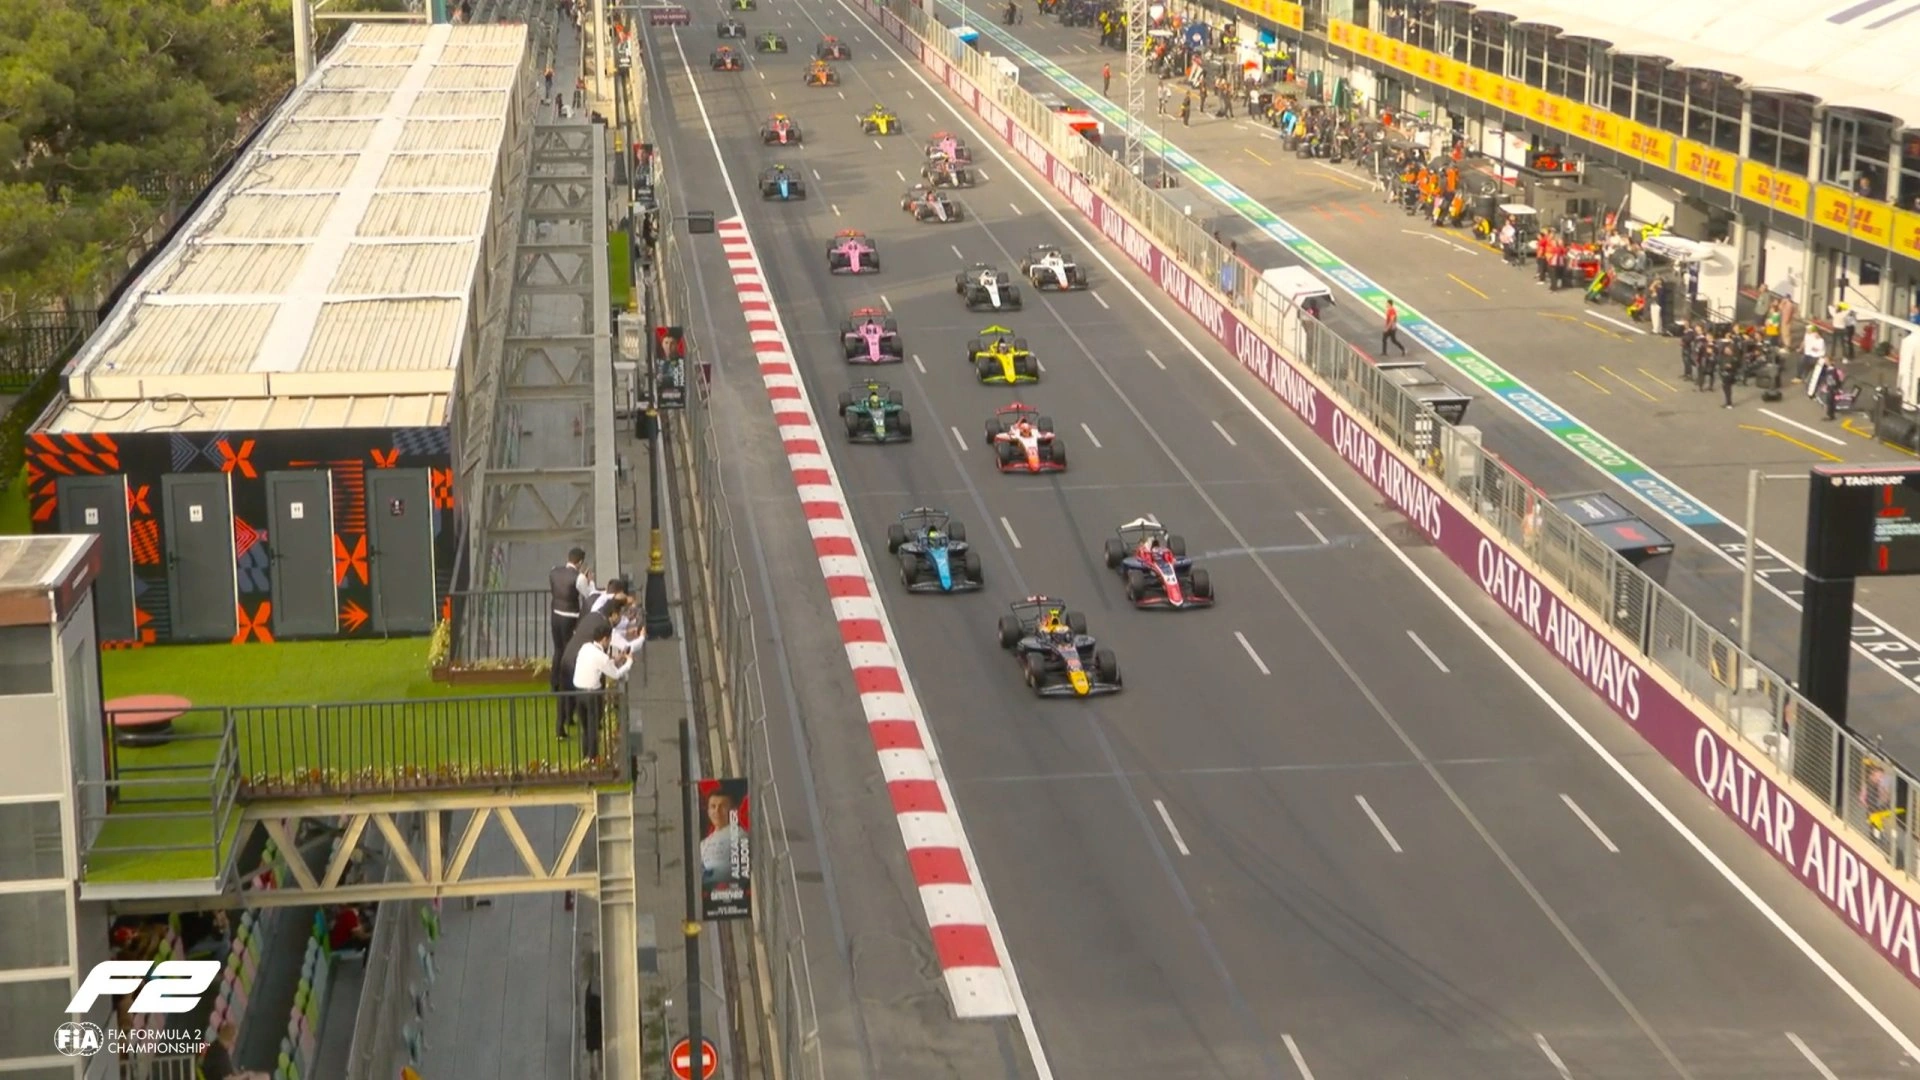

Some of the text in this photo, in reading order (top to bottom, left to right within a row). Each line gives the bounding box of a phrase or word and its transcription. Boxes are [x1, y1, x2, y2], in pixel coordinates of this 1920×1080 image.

[1687, 152, 1724, 182] DHL
[1755, 174, 1794, 206] DHL
[1829, 200, 1876, 234] DHL
[1235, 322, 1317, 425] QATAR AIRWAYS
[1332, 408, 1441, 539] QATAR AIRWAYS
[1478, 538, 1640, 720] QATAR AIRWAYS
[1694, 728, 1920, 979] QATAR AIRWA
